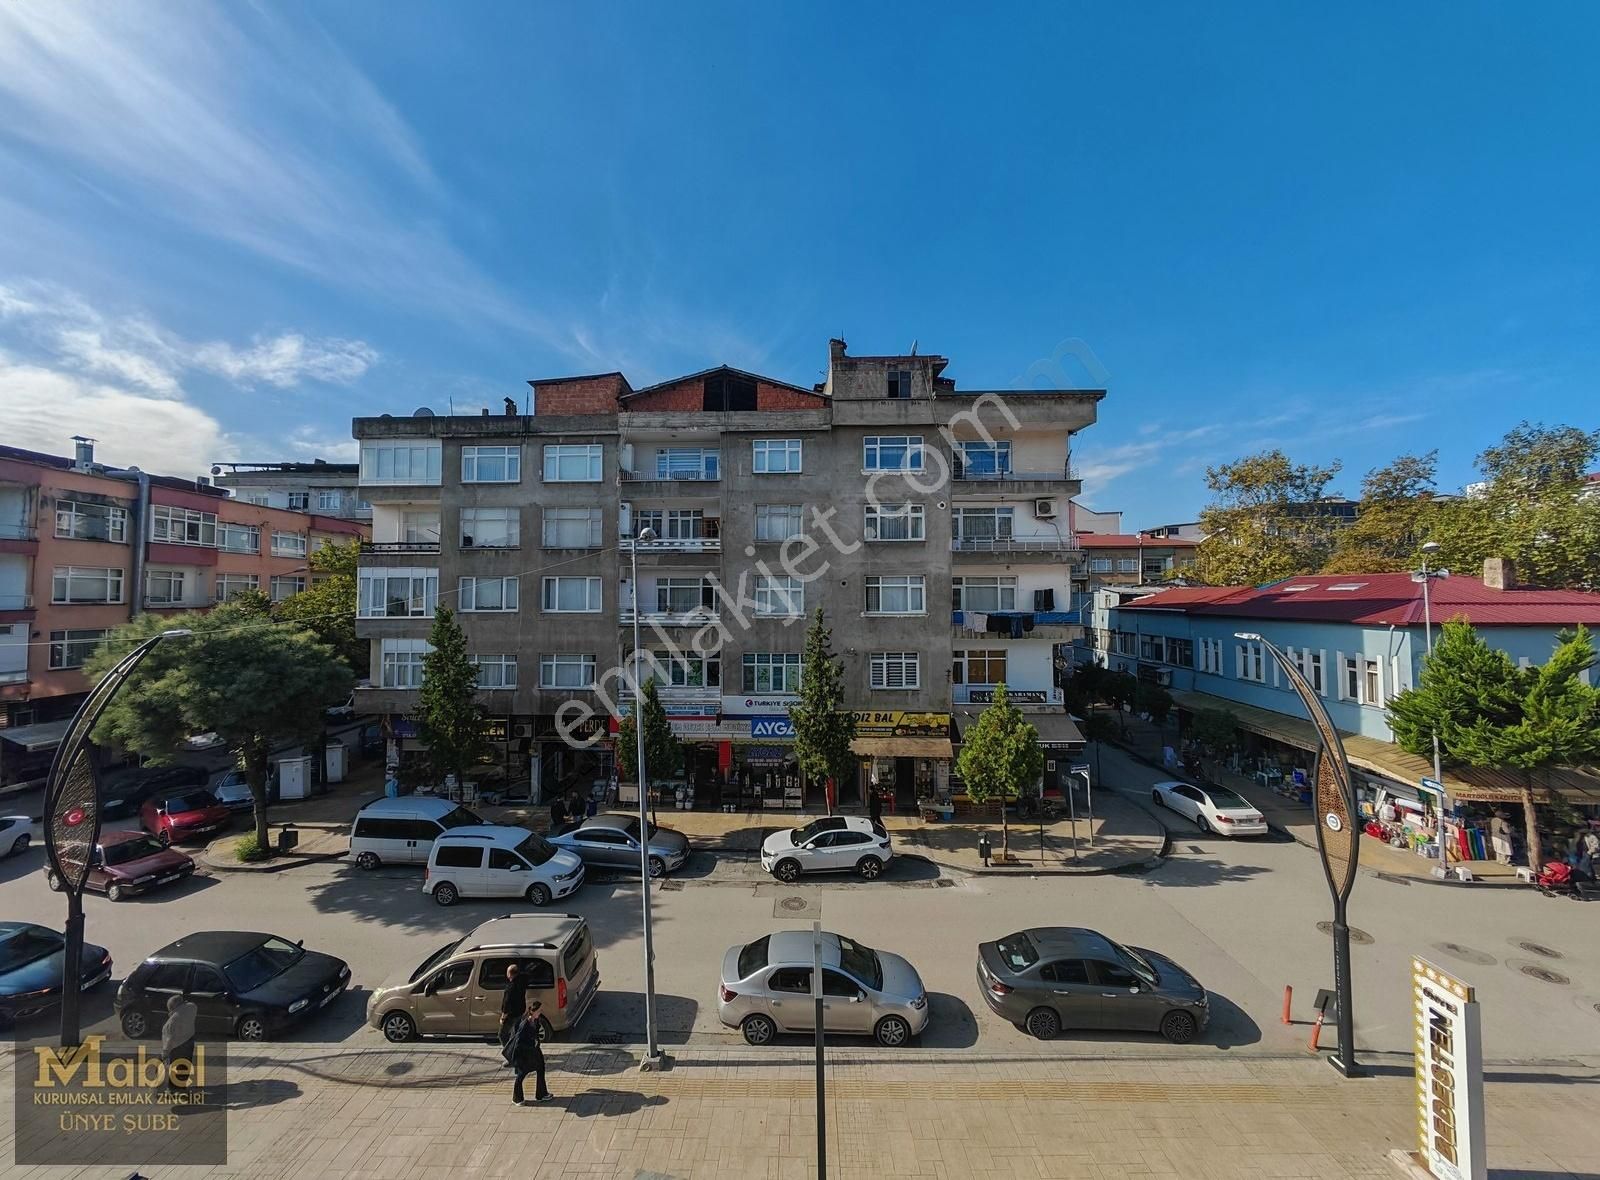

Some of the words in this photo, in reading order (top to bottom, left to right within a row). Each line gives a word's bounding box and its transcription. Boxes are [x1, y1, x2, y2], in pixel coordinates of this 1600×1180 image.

[874, 713, 894, 723] BAL
[753, 721, 798, 735] AYGA
[1429, 1007, 1458, 1167] BEDESTEN
